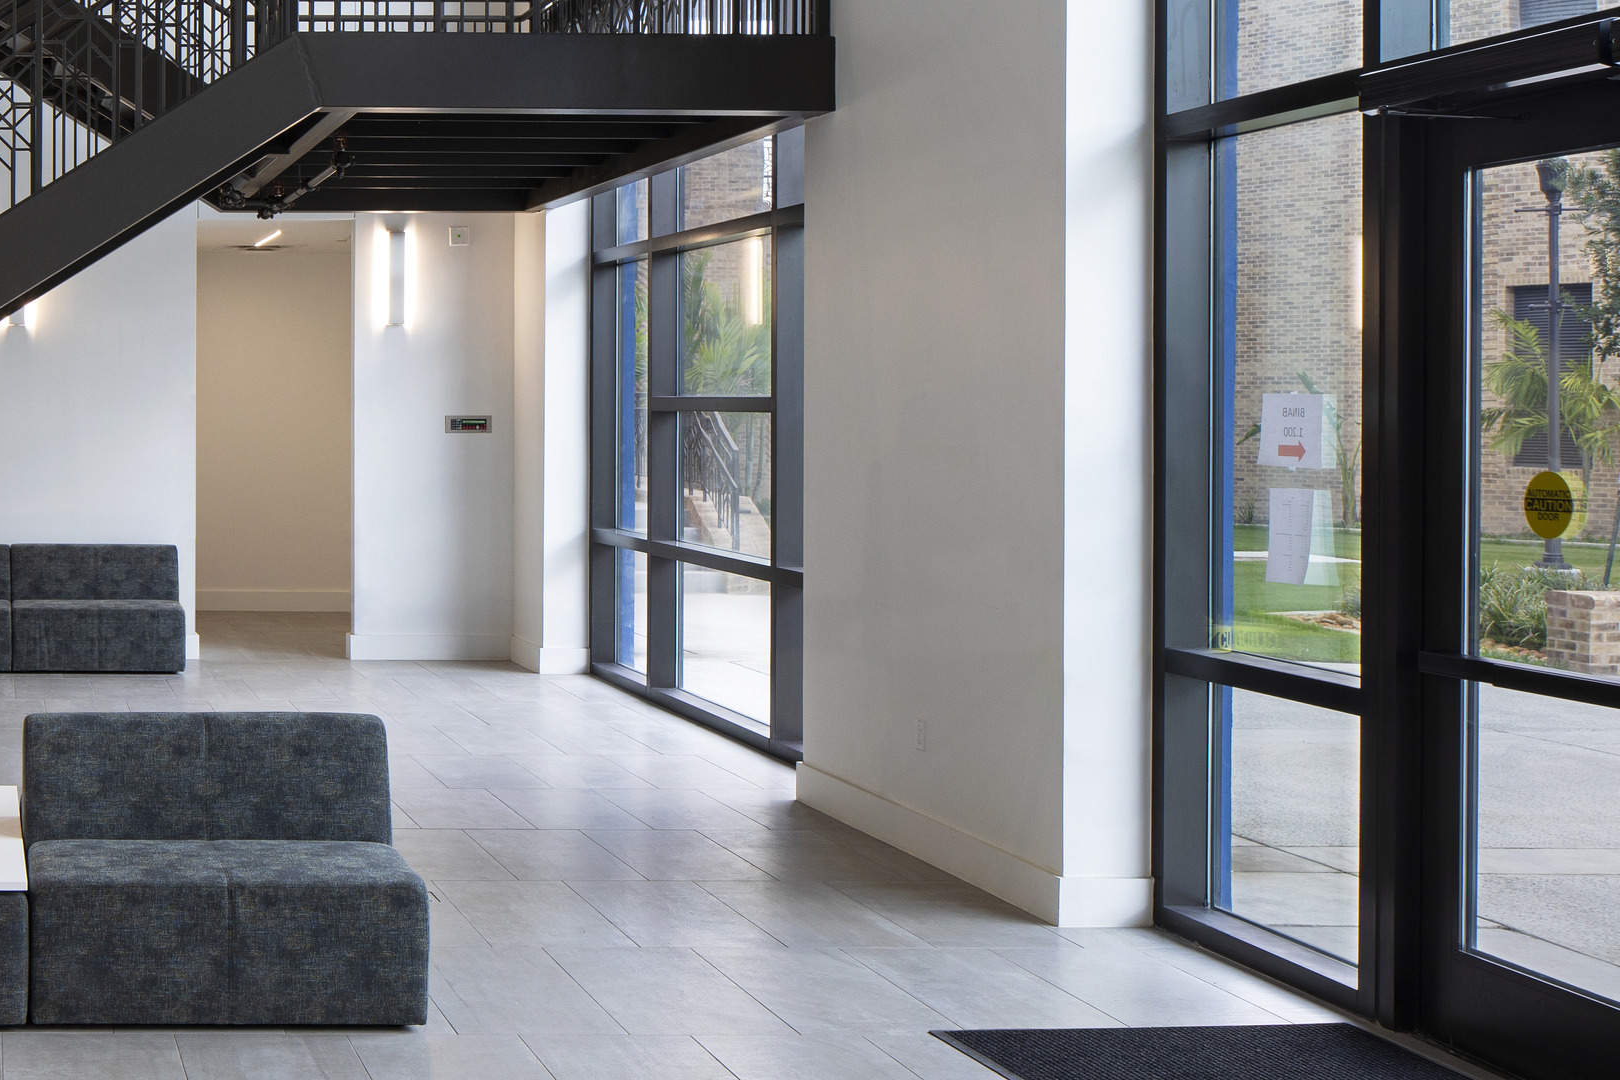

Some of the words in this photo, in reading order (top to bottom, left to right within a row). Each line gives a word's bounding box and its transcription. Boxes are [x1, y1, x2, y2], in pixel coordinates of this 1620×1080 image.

[1527, 488, 1571, 498] AUTOMATIC
[1525, 498, 1572, 512] CAUTION
[1537, 512, 1560, 521] DOOR
